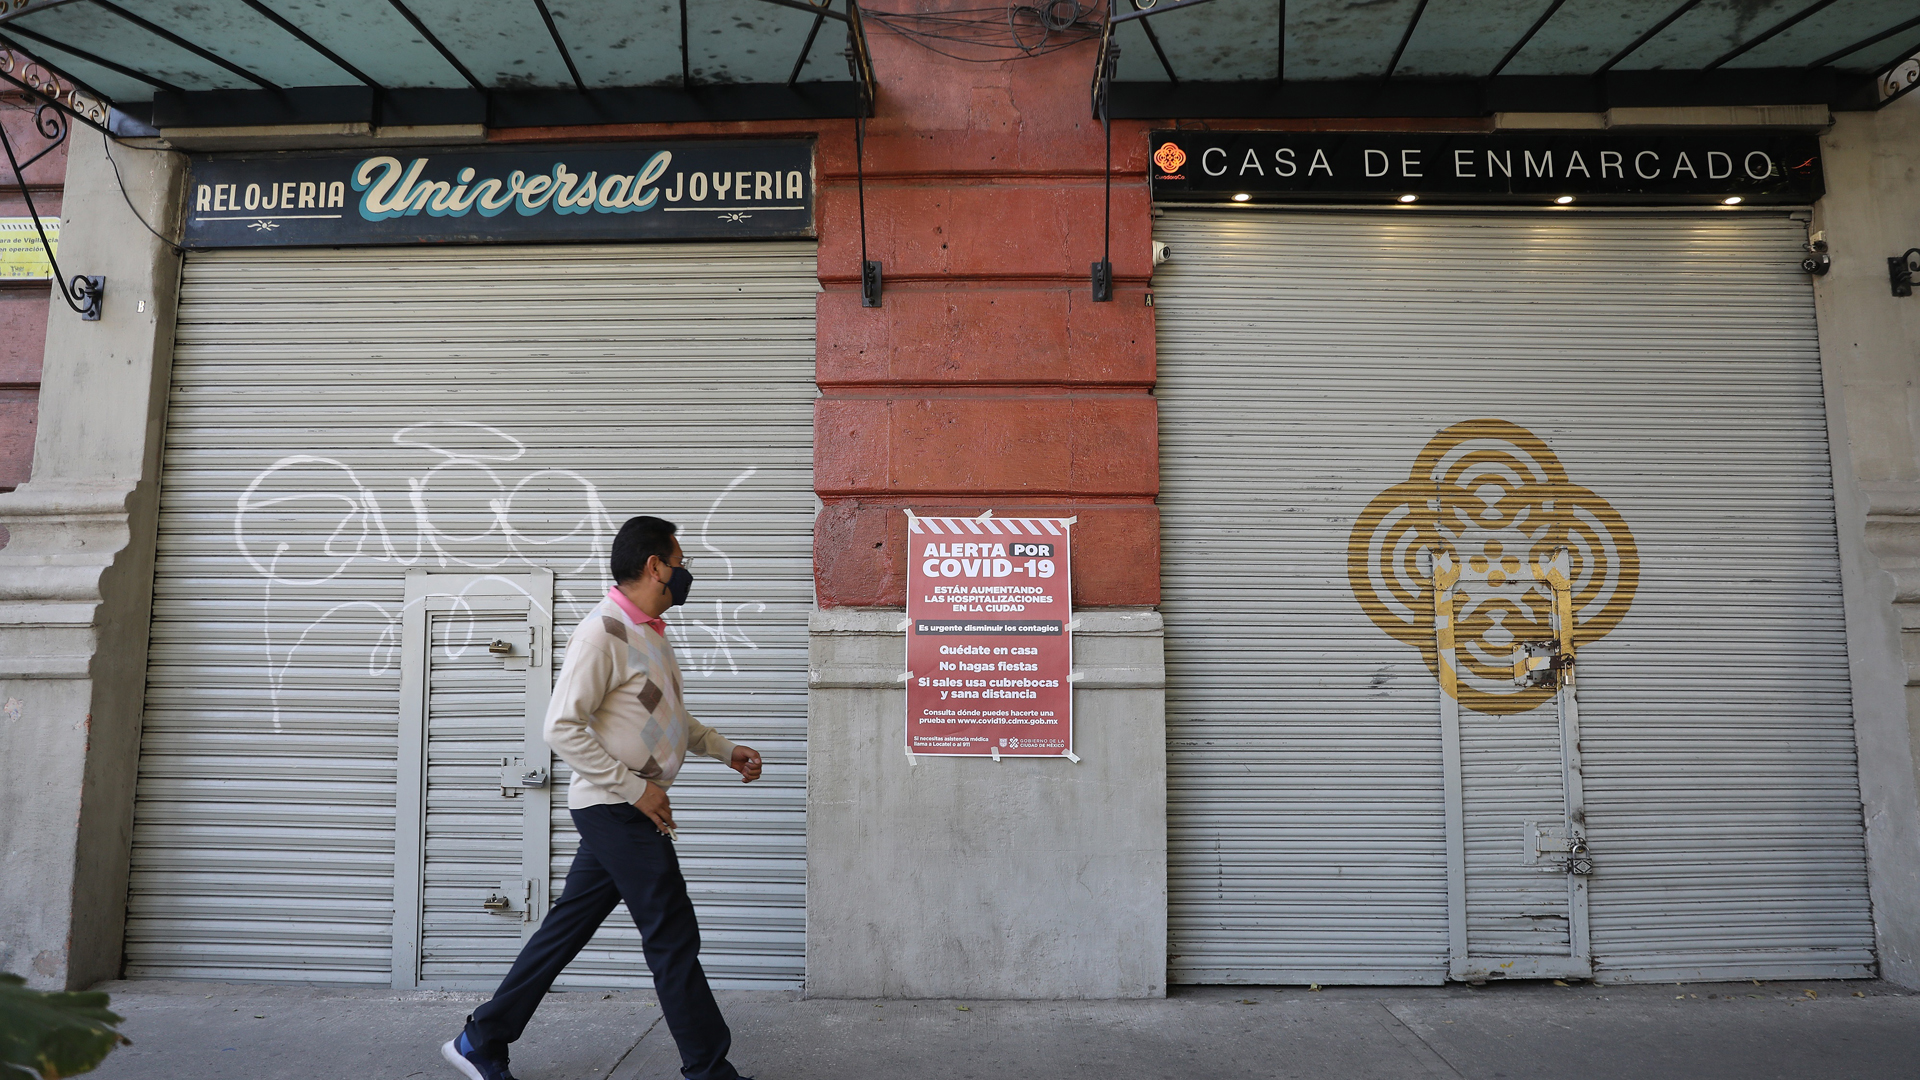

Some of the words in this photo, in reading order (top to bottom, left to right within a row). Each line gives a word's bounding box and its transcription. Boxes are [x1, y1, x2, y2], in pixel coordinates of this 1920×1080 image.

[1201, 146, 1335, 178] CASA
[1364, 149, 1424, 179] DE
[1455, 149, 1774, 182] ENMARCADO
[196, 181, 345, 212] RELOJERIA
[352, 150, 673, 222] Universal
[665, 169, 804, 202] JOYERIA
[1145, 294, 1153, 306] A
[923, 543, 1006, 557] ALERTA
[1014, 544, 1050, 557] POR
[922, 558, 1055, 578] COVID-19
[934, 585, 969, 594] ESTÁN
[970, 586, 1044, 594] AUMENTANDO
[924, 595, 945, 603] LAS
[946, 595, 1053, 603] HOSPITALIZACIONES
[985, 604, 1025, 612] CIUDAD
[918, 624, 929, 632] Es
[930, 625, 963, 633] urgente
[964, 624, 1003, 632] disminuir
[1004, 624, 1018, 632] los
[1018, 625, 1059, 634] contagios
[939, 645, 991, 656] Quédate
[993, 647, 1009, 655] en
[1010, 647, 1038, 656] casa
[939, 661, 957, 671] No
[958, 661, 995, 673] hagas
[997, 661, 1038, 672] fiestas
[918, 677, 930, 687] Si
[932, 677, 963, 687] sales
[989, 678, 1059, 688] cubrebocas
[940, 691, 948, 700] y
[950, 691, 979, 699] sana
[981, 689, 1037, 700] distancia
[982, 709, 1010, 718] puedes
[919, 717, 946, 725] prueba
[957, 717, 1058, 726] www.covid19.cdmx.gob.mx
